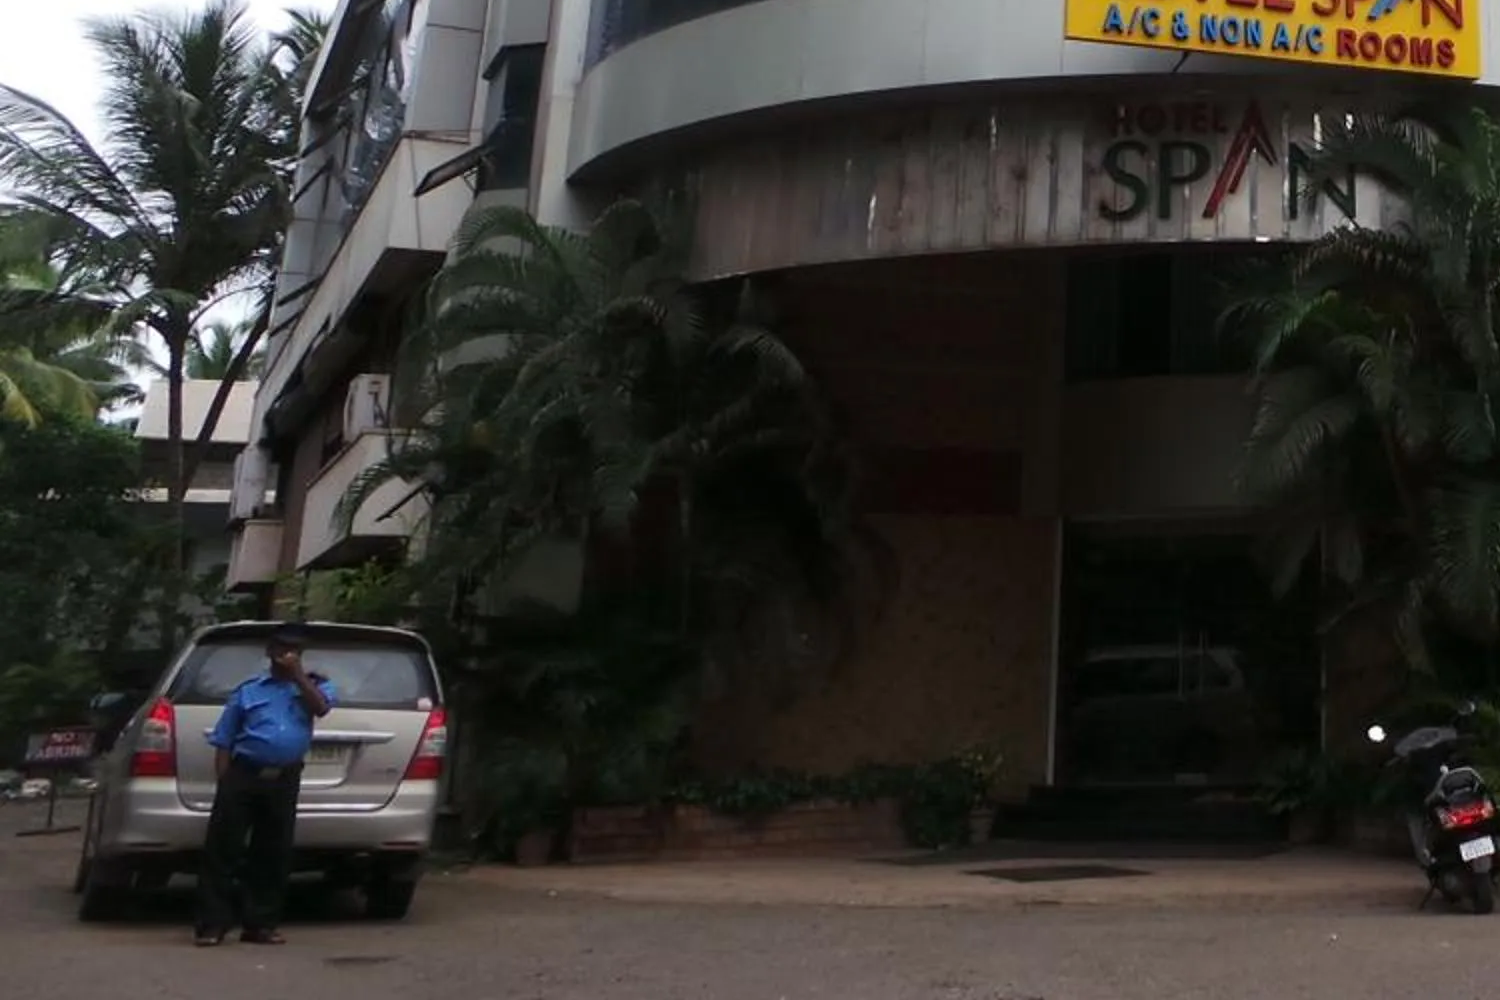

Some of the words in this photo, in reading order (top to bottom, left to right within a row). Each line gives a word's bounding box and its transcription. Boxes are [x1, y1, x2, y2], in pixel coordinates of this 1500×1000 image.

[1104, 3, 1160, 36] A/C
[1171, 13, 1190, 40] &
[1200, 14, 1263, 49] NON
[1272, 22, 1324, 54] A/C
[1337, 29, 1455, 68] ROOMS
[1110, 103, 1228, 137] HOTEL
[1100, 97, 1360, 228] SPAN
[51, 731, 76, 744] NO
